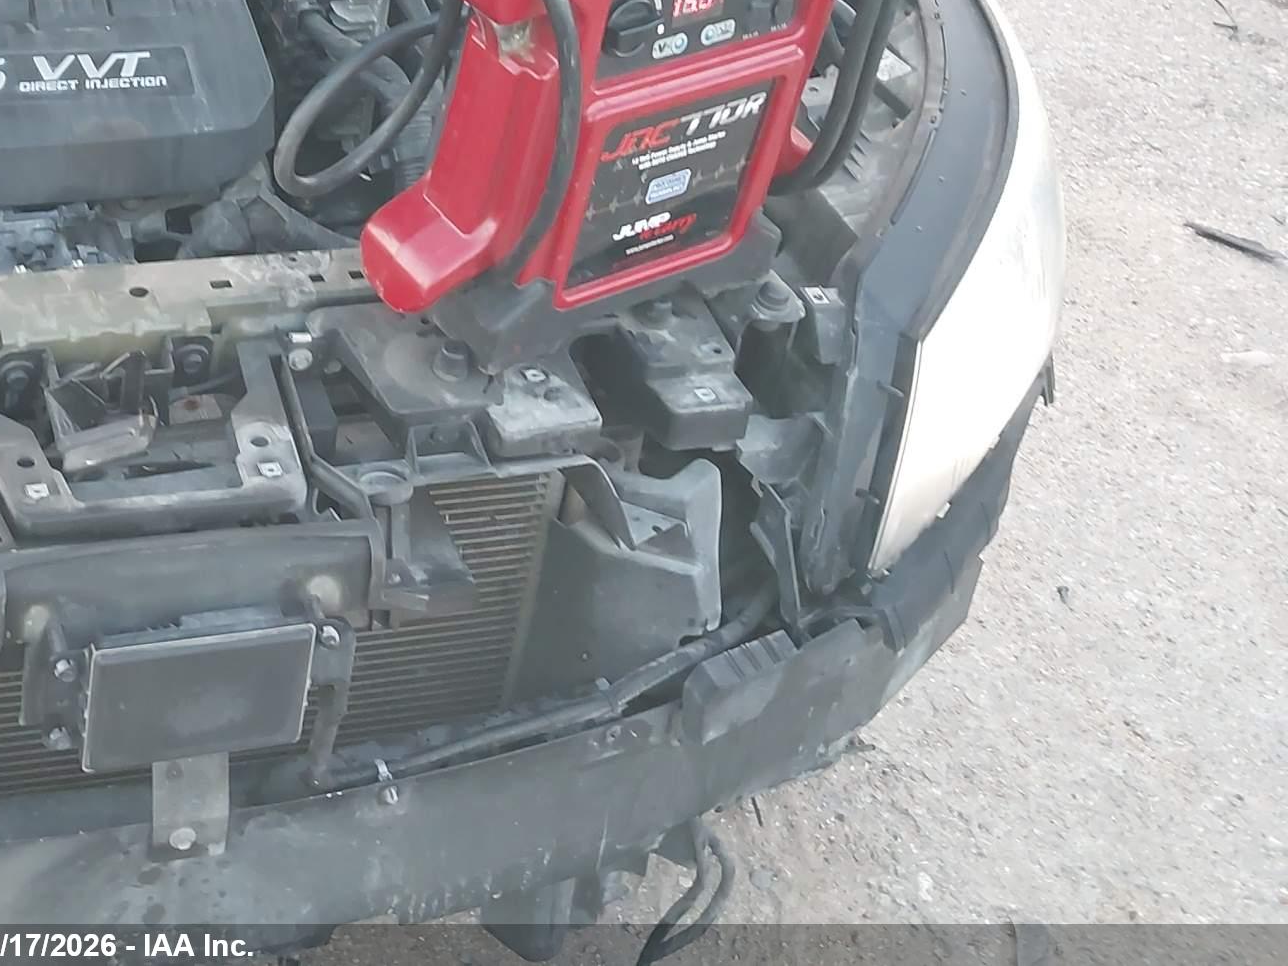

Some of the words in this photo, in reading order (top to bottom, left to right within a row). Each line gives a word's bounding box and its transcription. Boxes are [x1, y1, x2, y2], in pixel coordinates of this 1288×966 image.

[32, 51, 151, 81] VVT
[19, 79, 79, 93] DIRECT
[85, 75, 168, 90] INJECTION
[613, 212, 672, 241] JUMP
